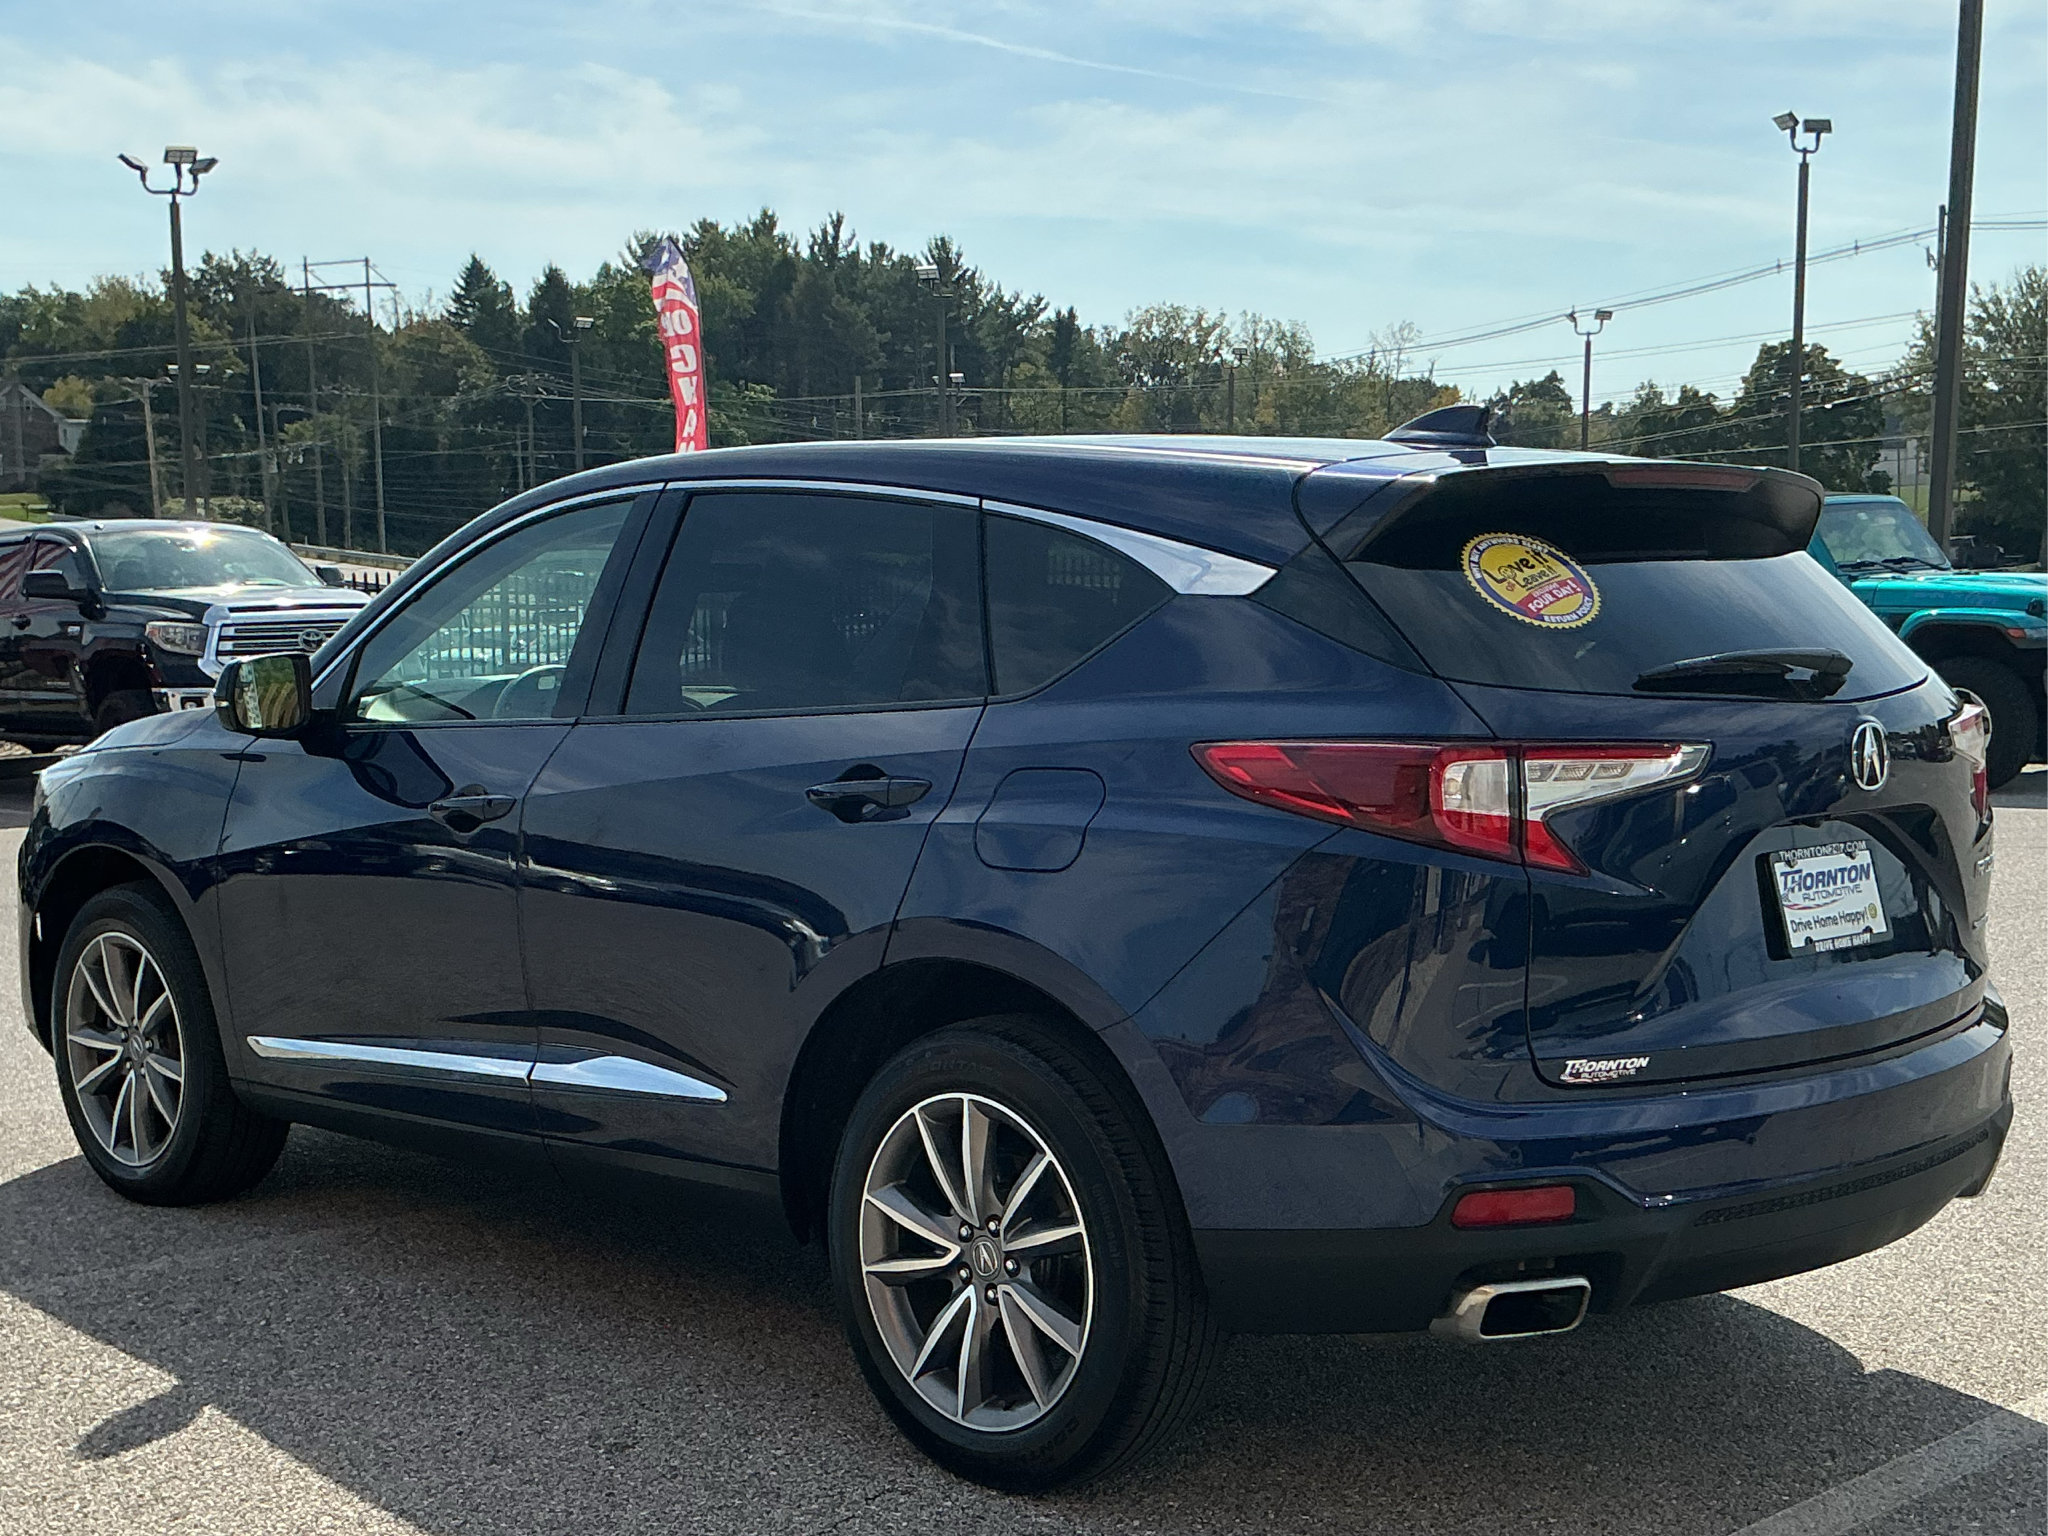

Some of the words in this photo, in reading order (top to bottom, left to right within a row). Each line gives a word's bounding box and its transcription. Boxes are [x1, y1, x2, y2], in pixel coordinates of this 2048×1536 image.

[1482, 557, 1536, 584] Love
[1513, 569, 1550, 588] Leave
[1527, 593, 1557, 612] FOUR
[1552, 579, 1582, 599] DAY!
[1543, 612, 1580, 622] RETURN
[1576, 596, 1593, 617] POLICY
[1780, 863, 1871, 893] THORNTON
[1802, 884, 1863, 902] AUTOMOTIVE
[1790, 917, 1813, 933] Drive
[1812, 914, 1838, 928] Home
[1565, 1056, 1651, 1076] THORNTON
[1580, 1068, 1637, 1079] AUTOMOTIVE
